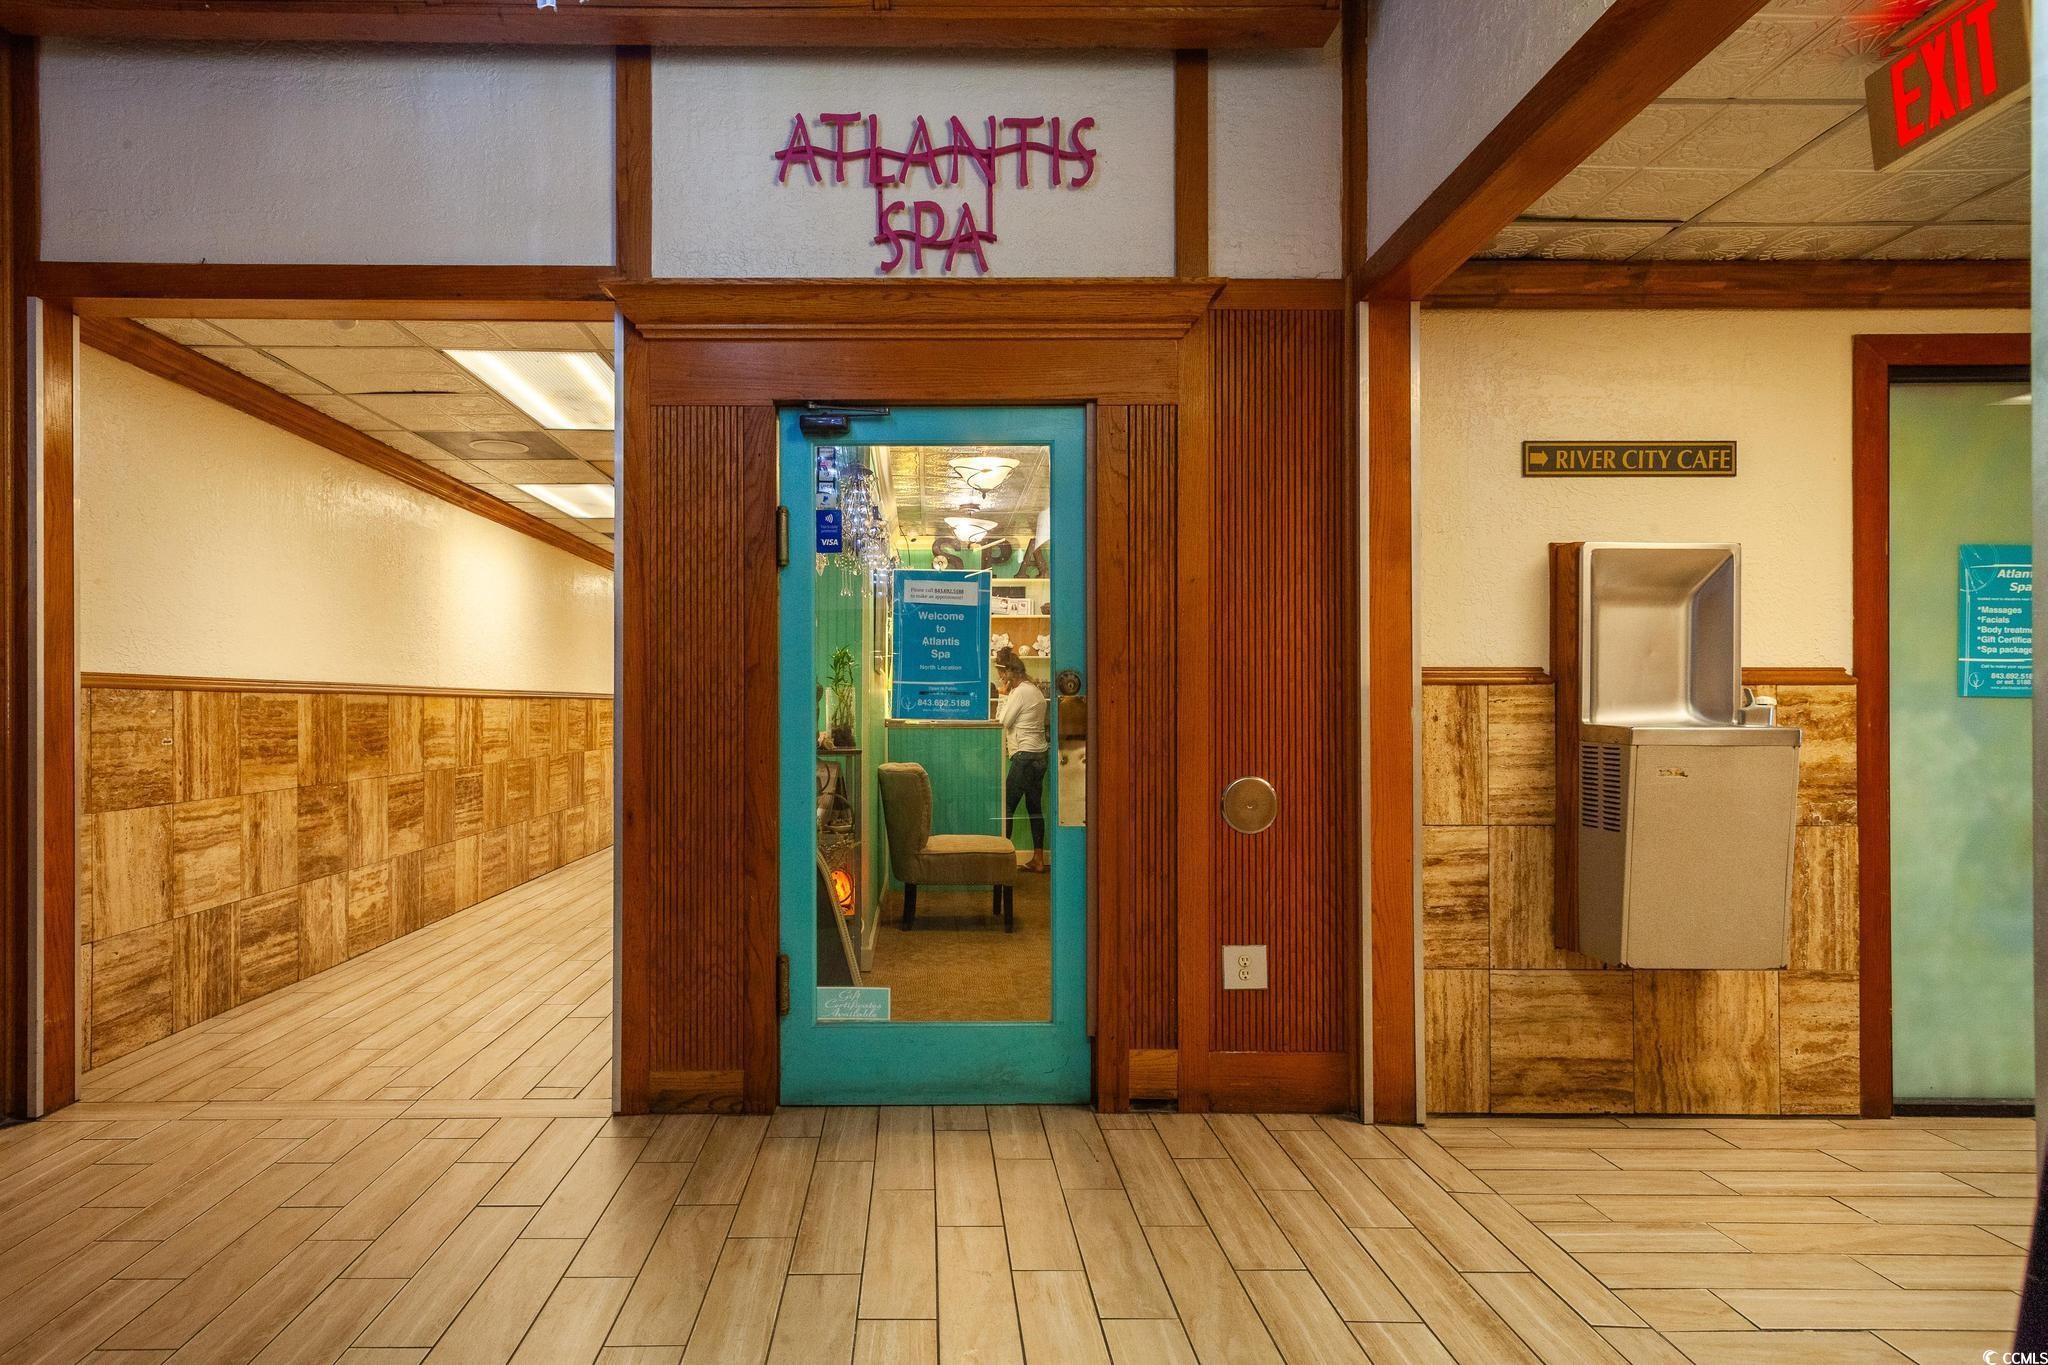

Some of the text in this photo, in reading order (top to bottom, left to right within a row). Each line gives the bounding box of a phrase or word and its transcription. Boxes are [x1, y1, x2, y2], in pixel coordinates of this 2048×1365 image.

[1889, 0, 1998, 149] EXIT
[775, 111, 1097, 187] ATLANTIS
[878, 200, 993, 272] SPA
[1555, 449, 1731, 470] RIVER CITY CAFE
[820, 538, 839, 546] VISA
[2009, 582, 2033, 594] Spa
[918, 611, 965, 621] Welcome
[936, 624, 946, 633] to
[922, 636, 960, 646] Atlantis
[930, 649, 951, 661] Spa
[917, 699, 971, 707] 843.692.5188
[838, 990, 861, 1002] Gift
